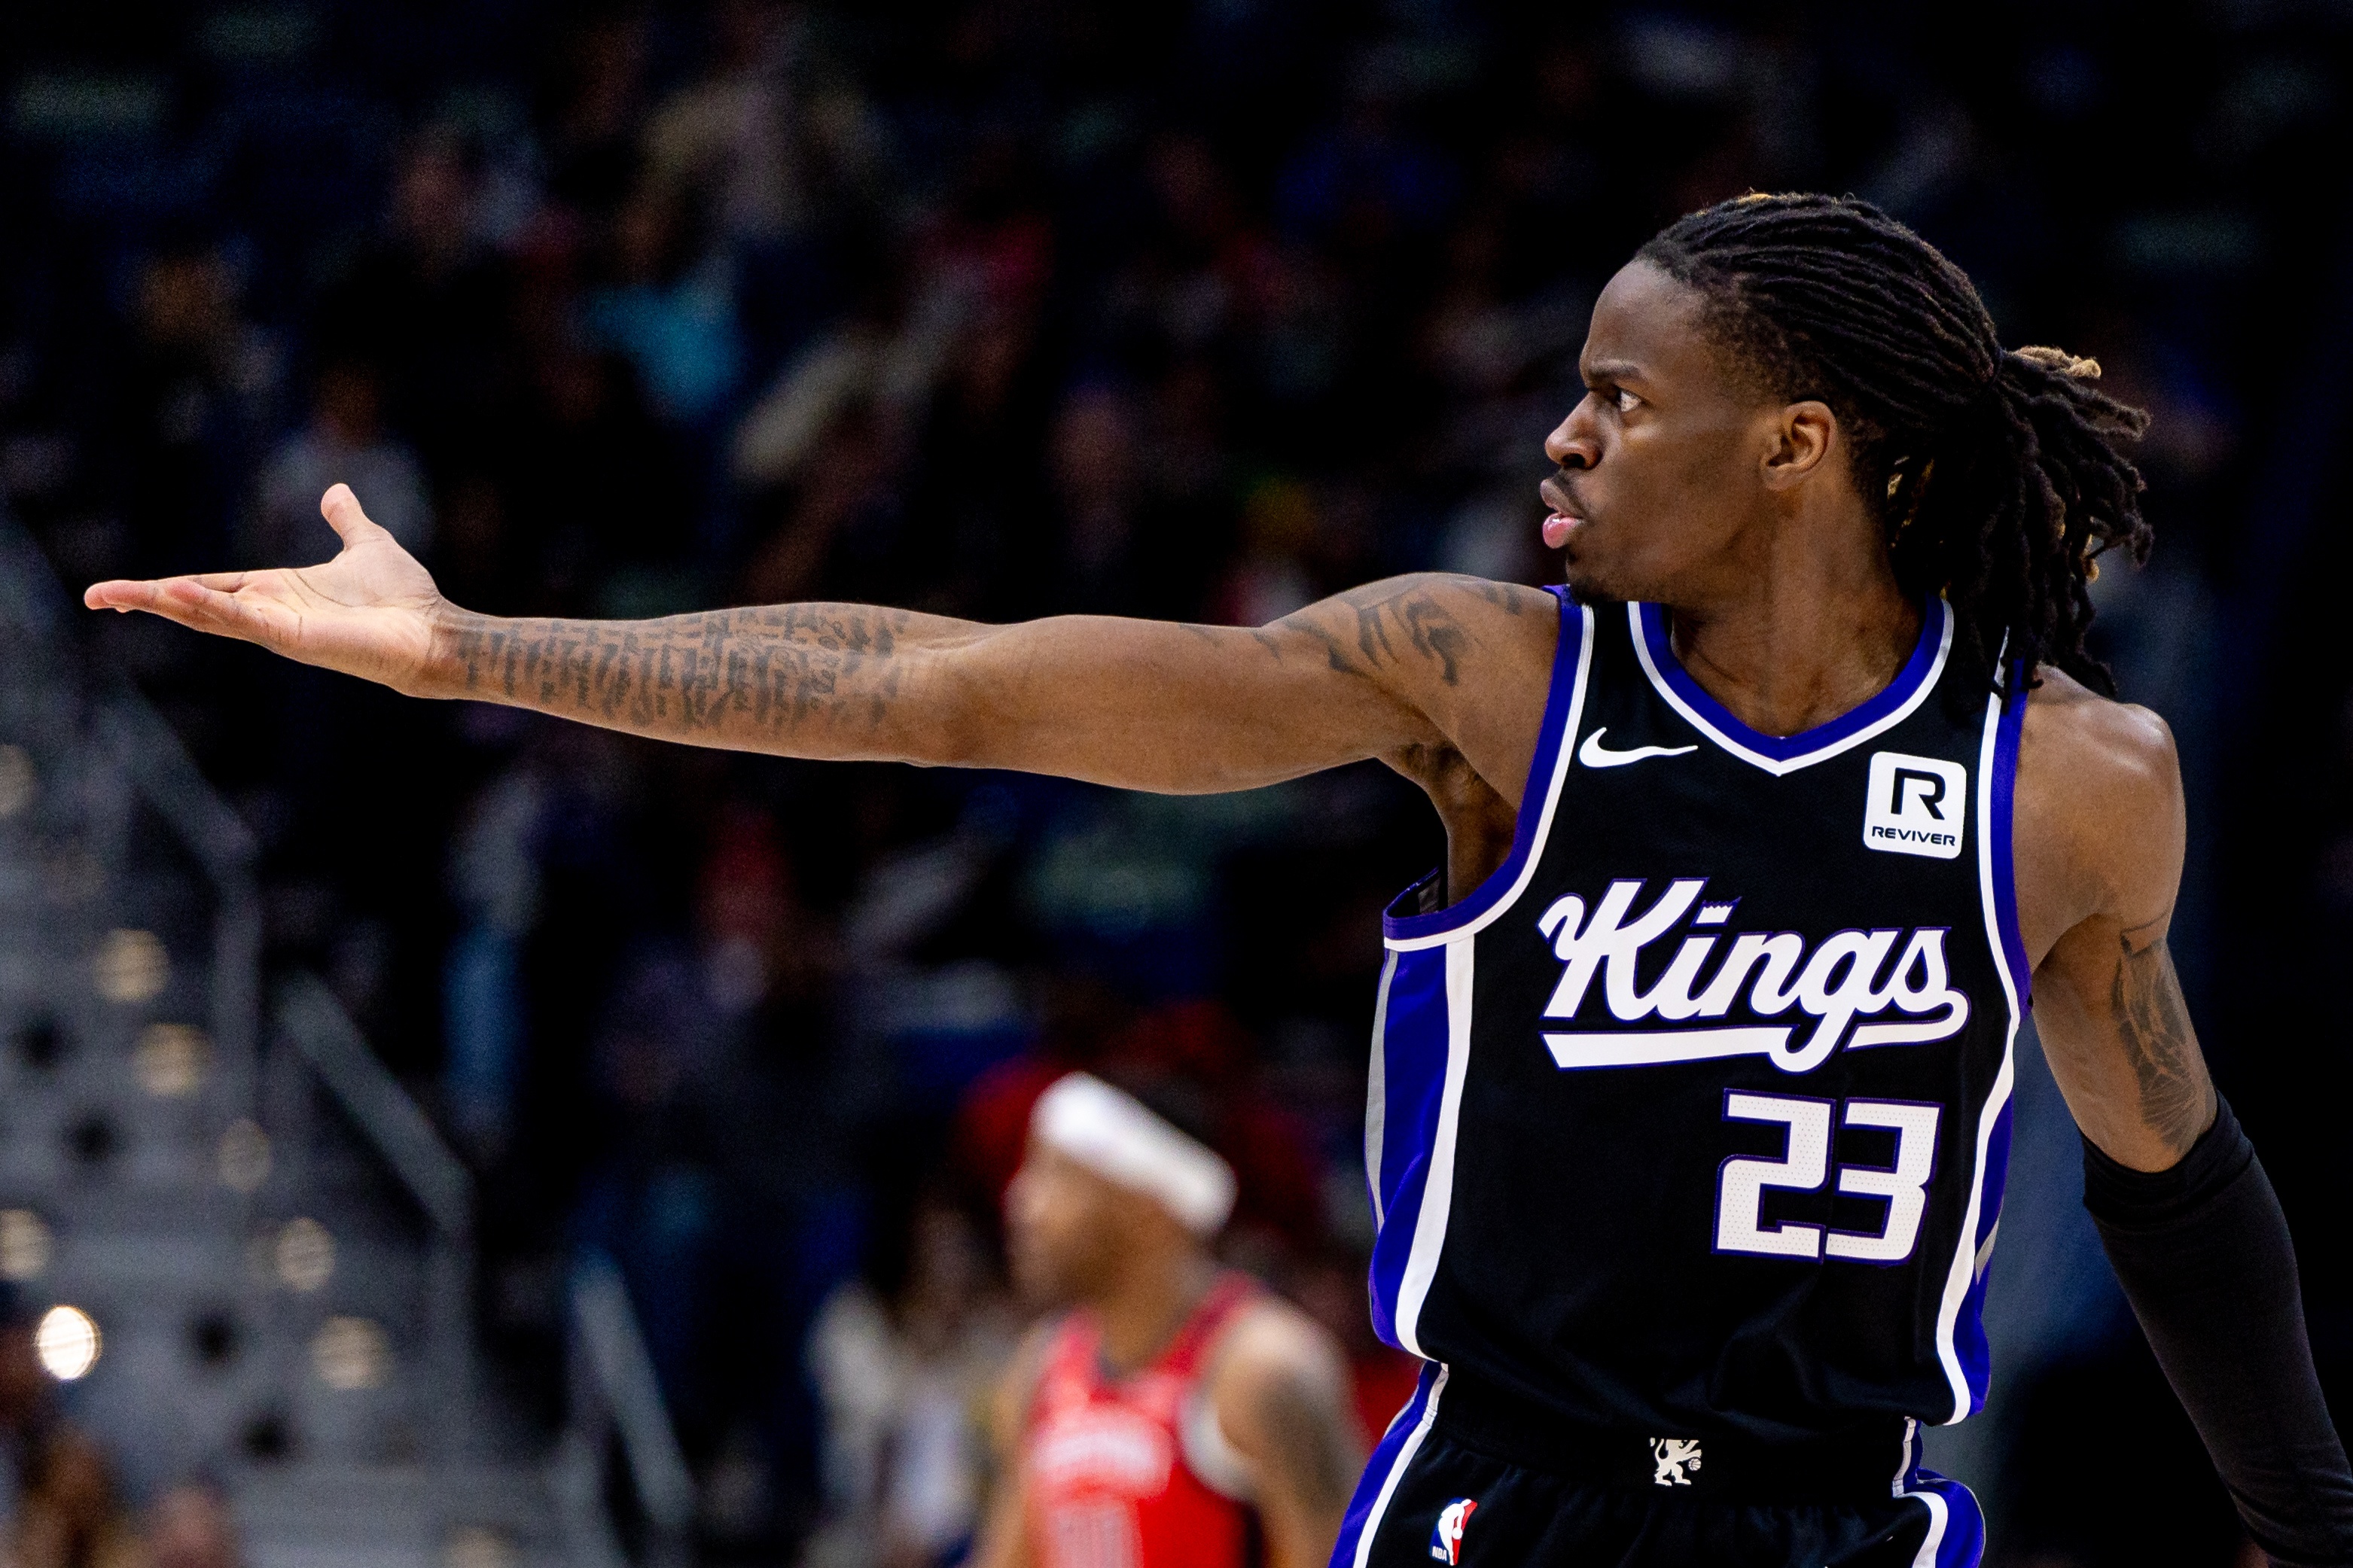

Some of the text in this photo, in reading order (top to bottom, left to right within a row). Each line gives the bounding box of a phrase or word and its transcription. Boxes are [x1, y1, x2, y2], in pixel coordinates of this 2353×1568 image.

[1891, 767, 1946, 821] R
[1871, 826, 1955, 846] REVIVER
[1538, 878, 1971, 1073] Kings
[1711, 1088, 1945, 1268] 23
[1431, 1545, 1447, 1562] NBA
